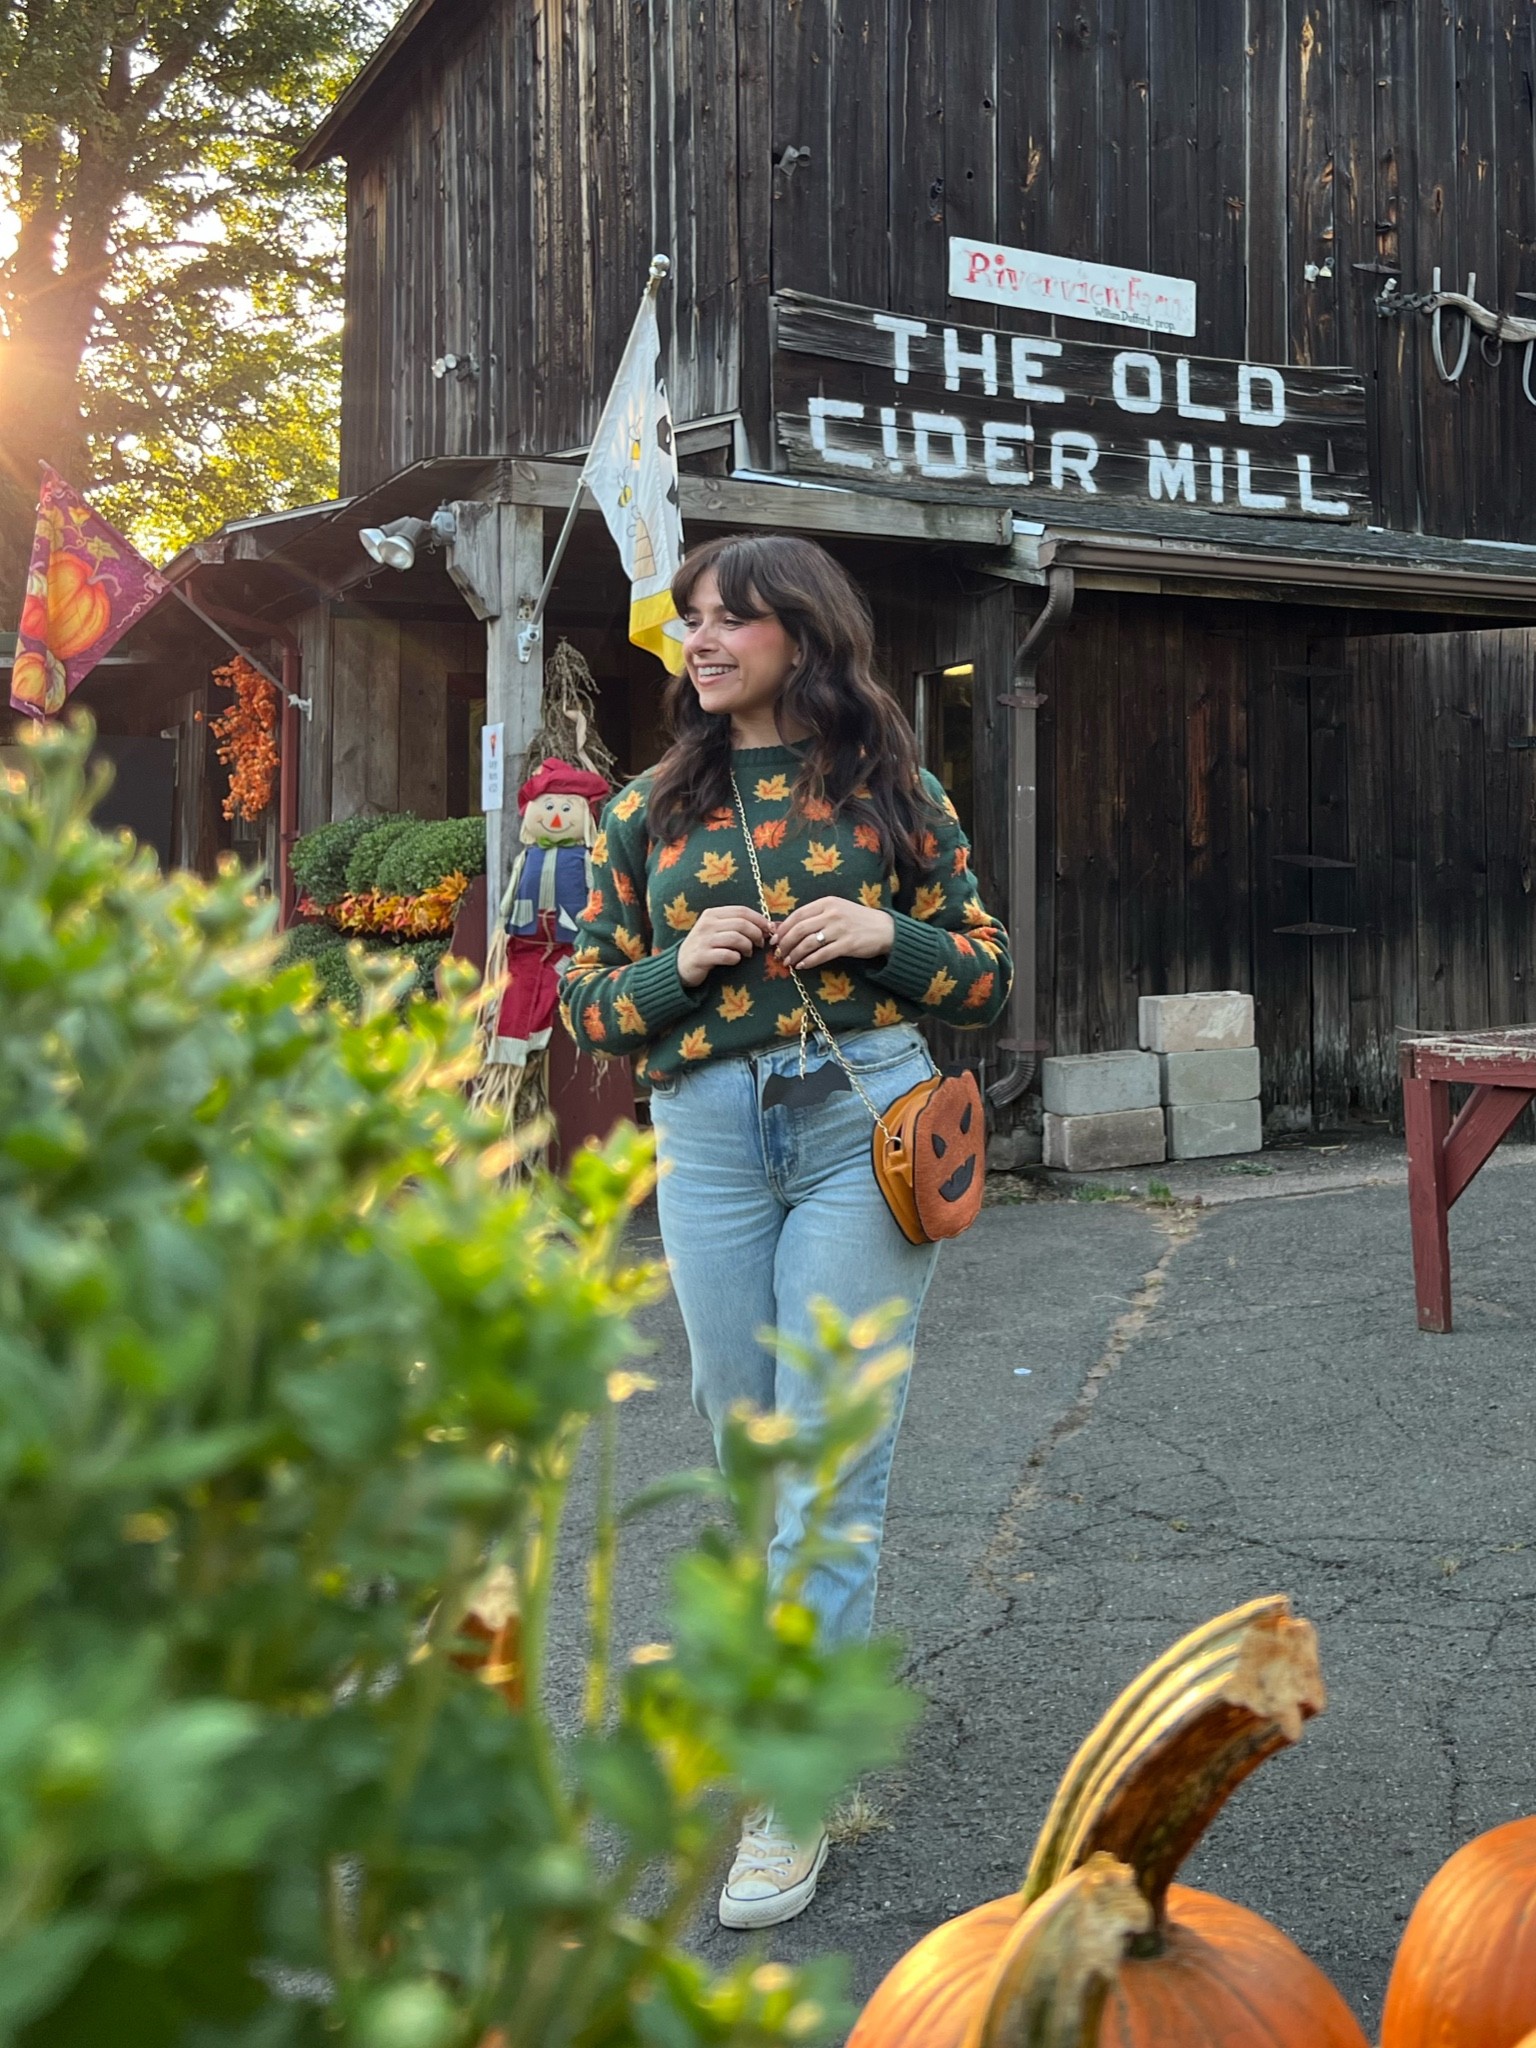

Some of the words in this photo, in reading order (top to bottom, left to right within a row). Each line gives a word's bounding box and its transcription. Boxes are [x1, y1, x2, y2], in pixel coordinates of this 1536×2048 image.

[873, 313, 1066, 403] THE
[1112, 351, 1287, 427] OLD
[808, 397, 1099, 494] CIDER
[1147, 439, 1350, 516] MILL
